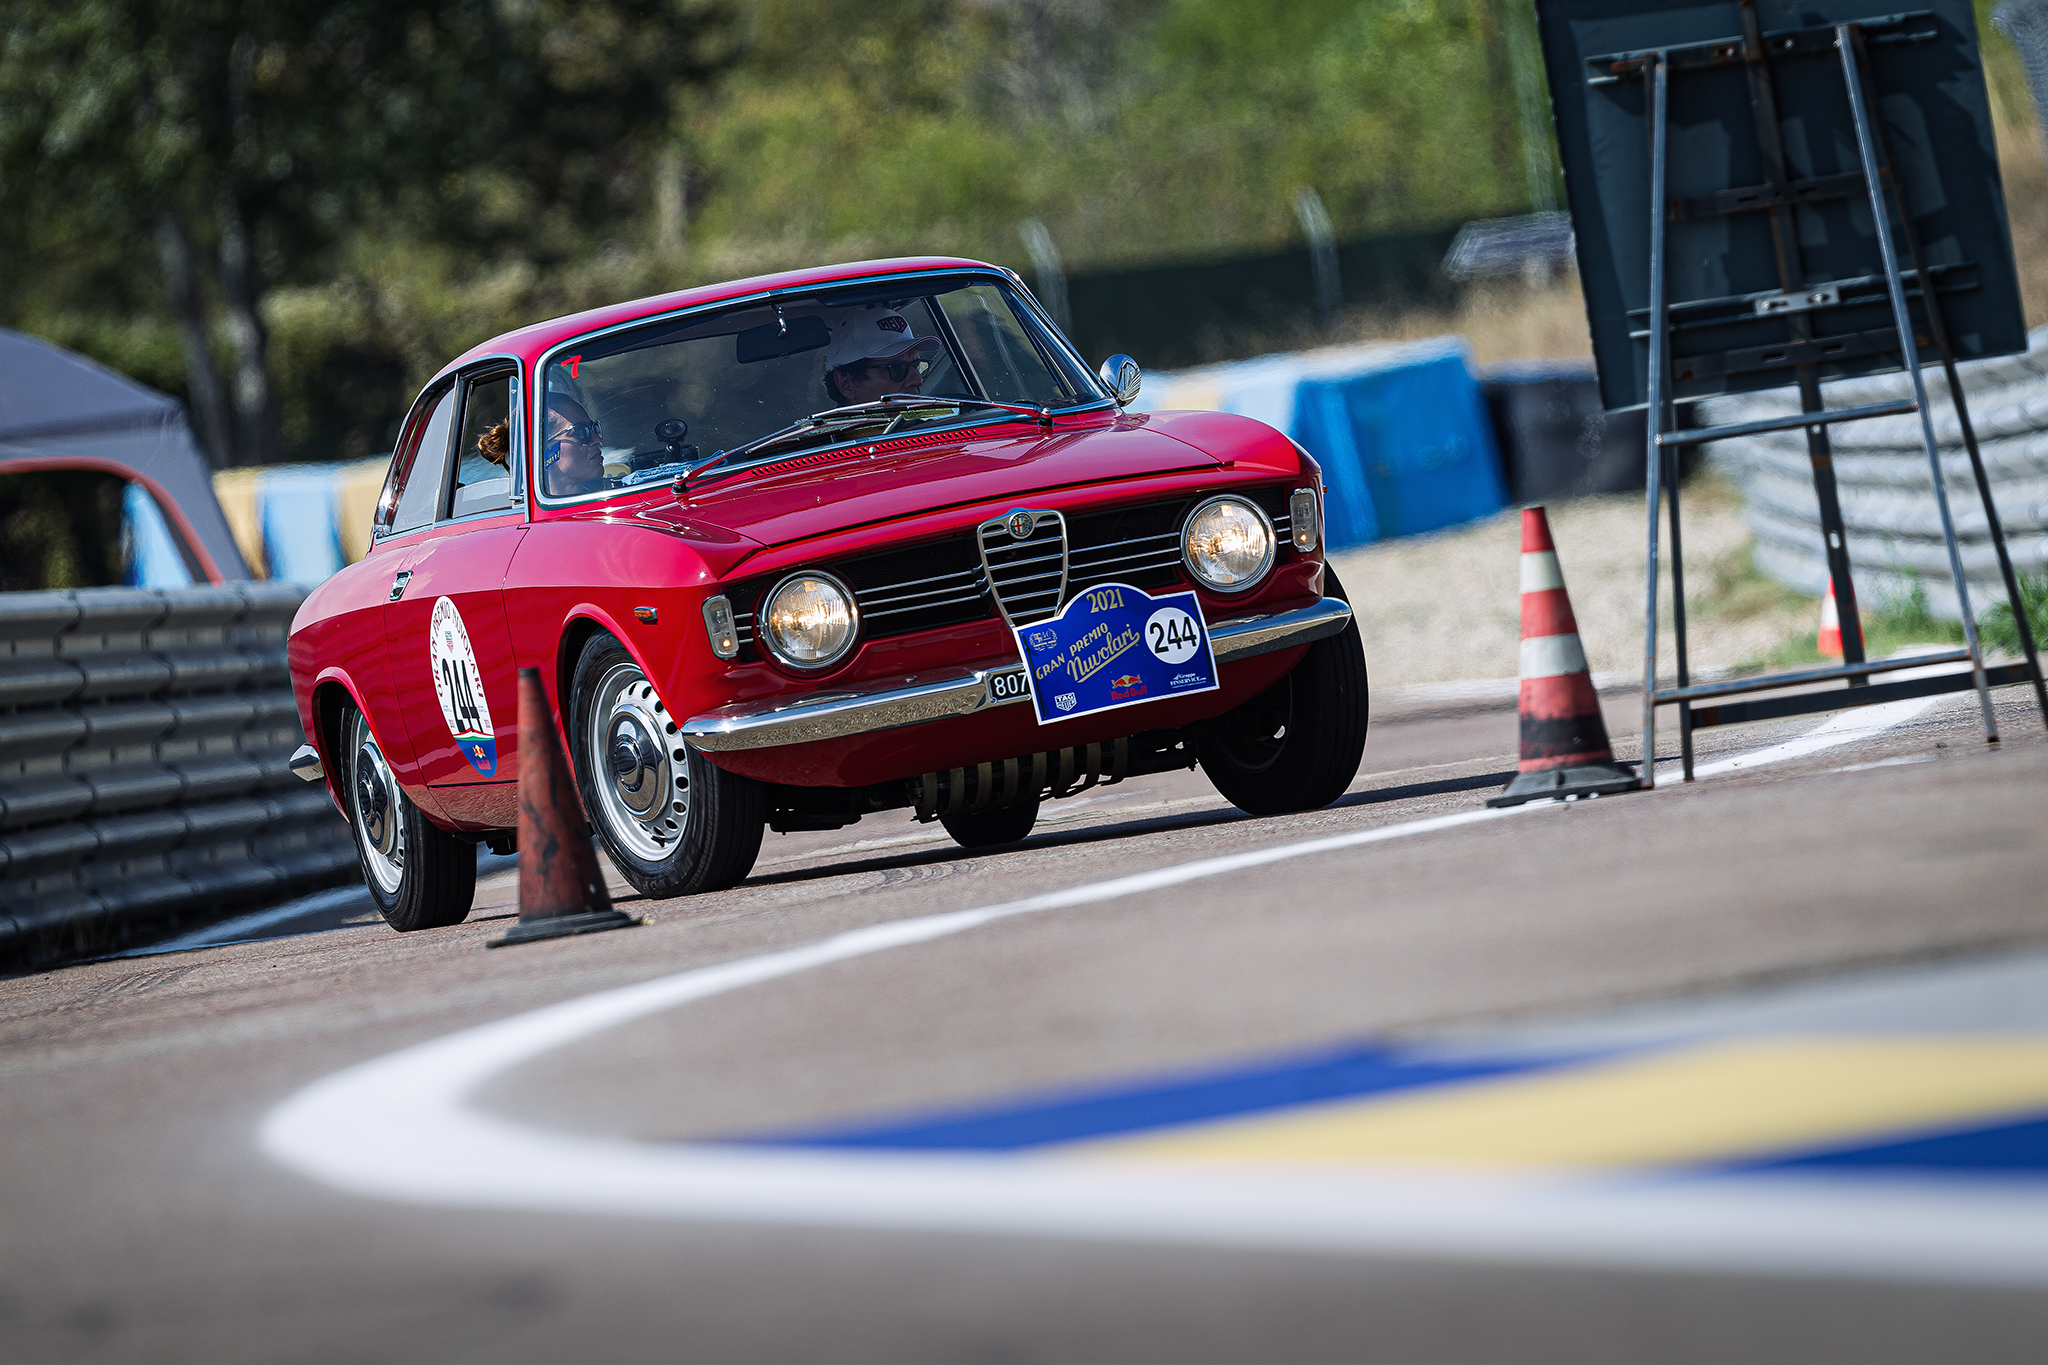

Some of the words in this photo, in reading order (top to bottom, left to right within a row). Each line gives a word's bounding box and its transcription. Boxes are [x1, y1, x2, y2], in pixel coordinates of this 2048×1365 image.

[1086, 588, 1125, 614] 2021
[1036, 652, 1066, 680] GRAN
[1069, 622, 1109, 657] PREMIO
[1149, 616, 1198, 654] 244
[1066, 623, 1141, 683] Nuvolari
[442, 658, 484, 733] 244
[995, 672, 1028, 696] 807
[1057, 694, 1074, 702] TAG
[1110, 688, 1130, 701] Red
[1130, 684, 1148, 697] Bull
